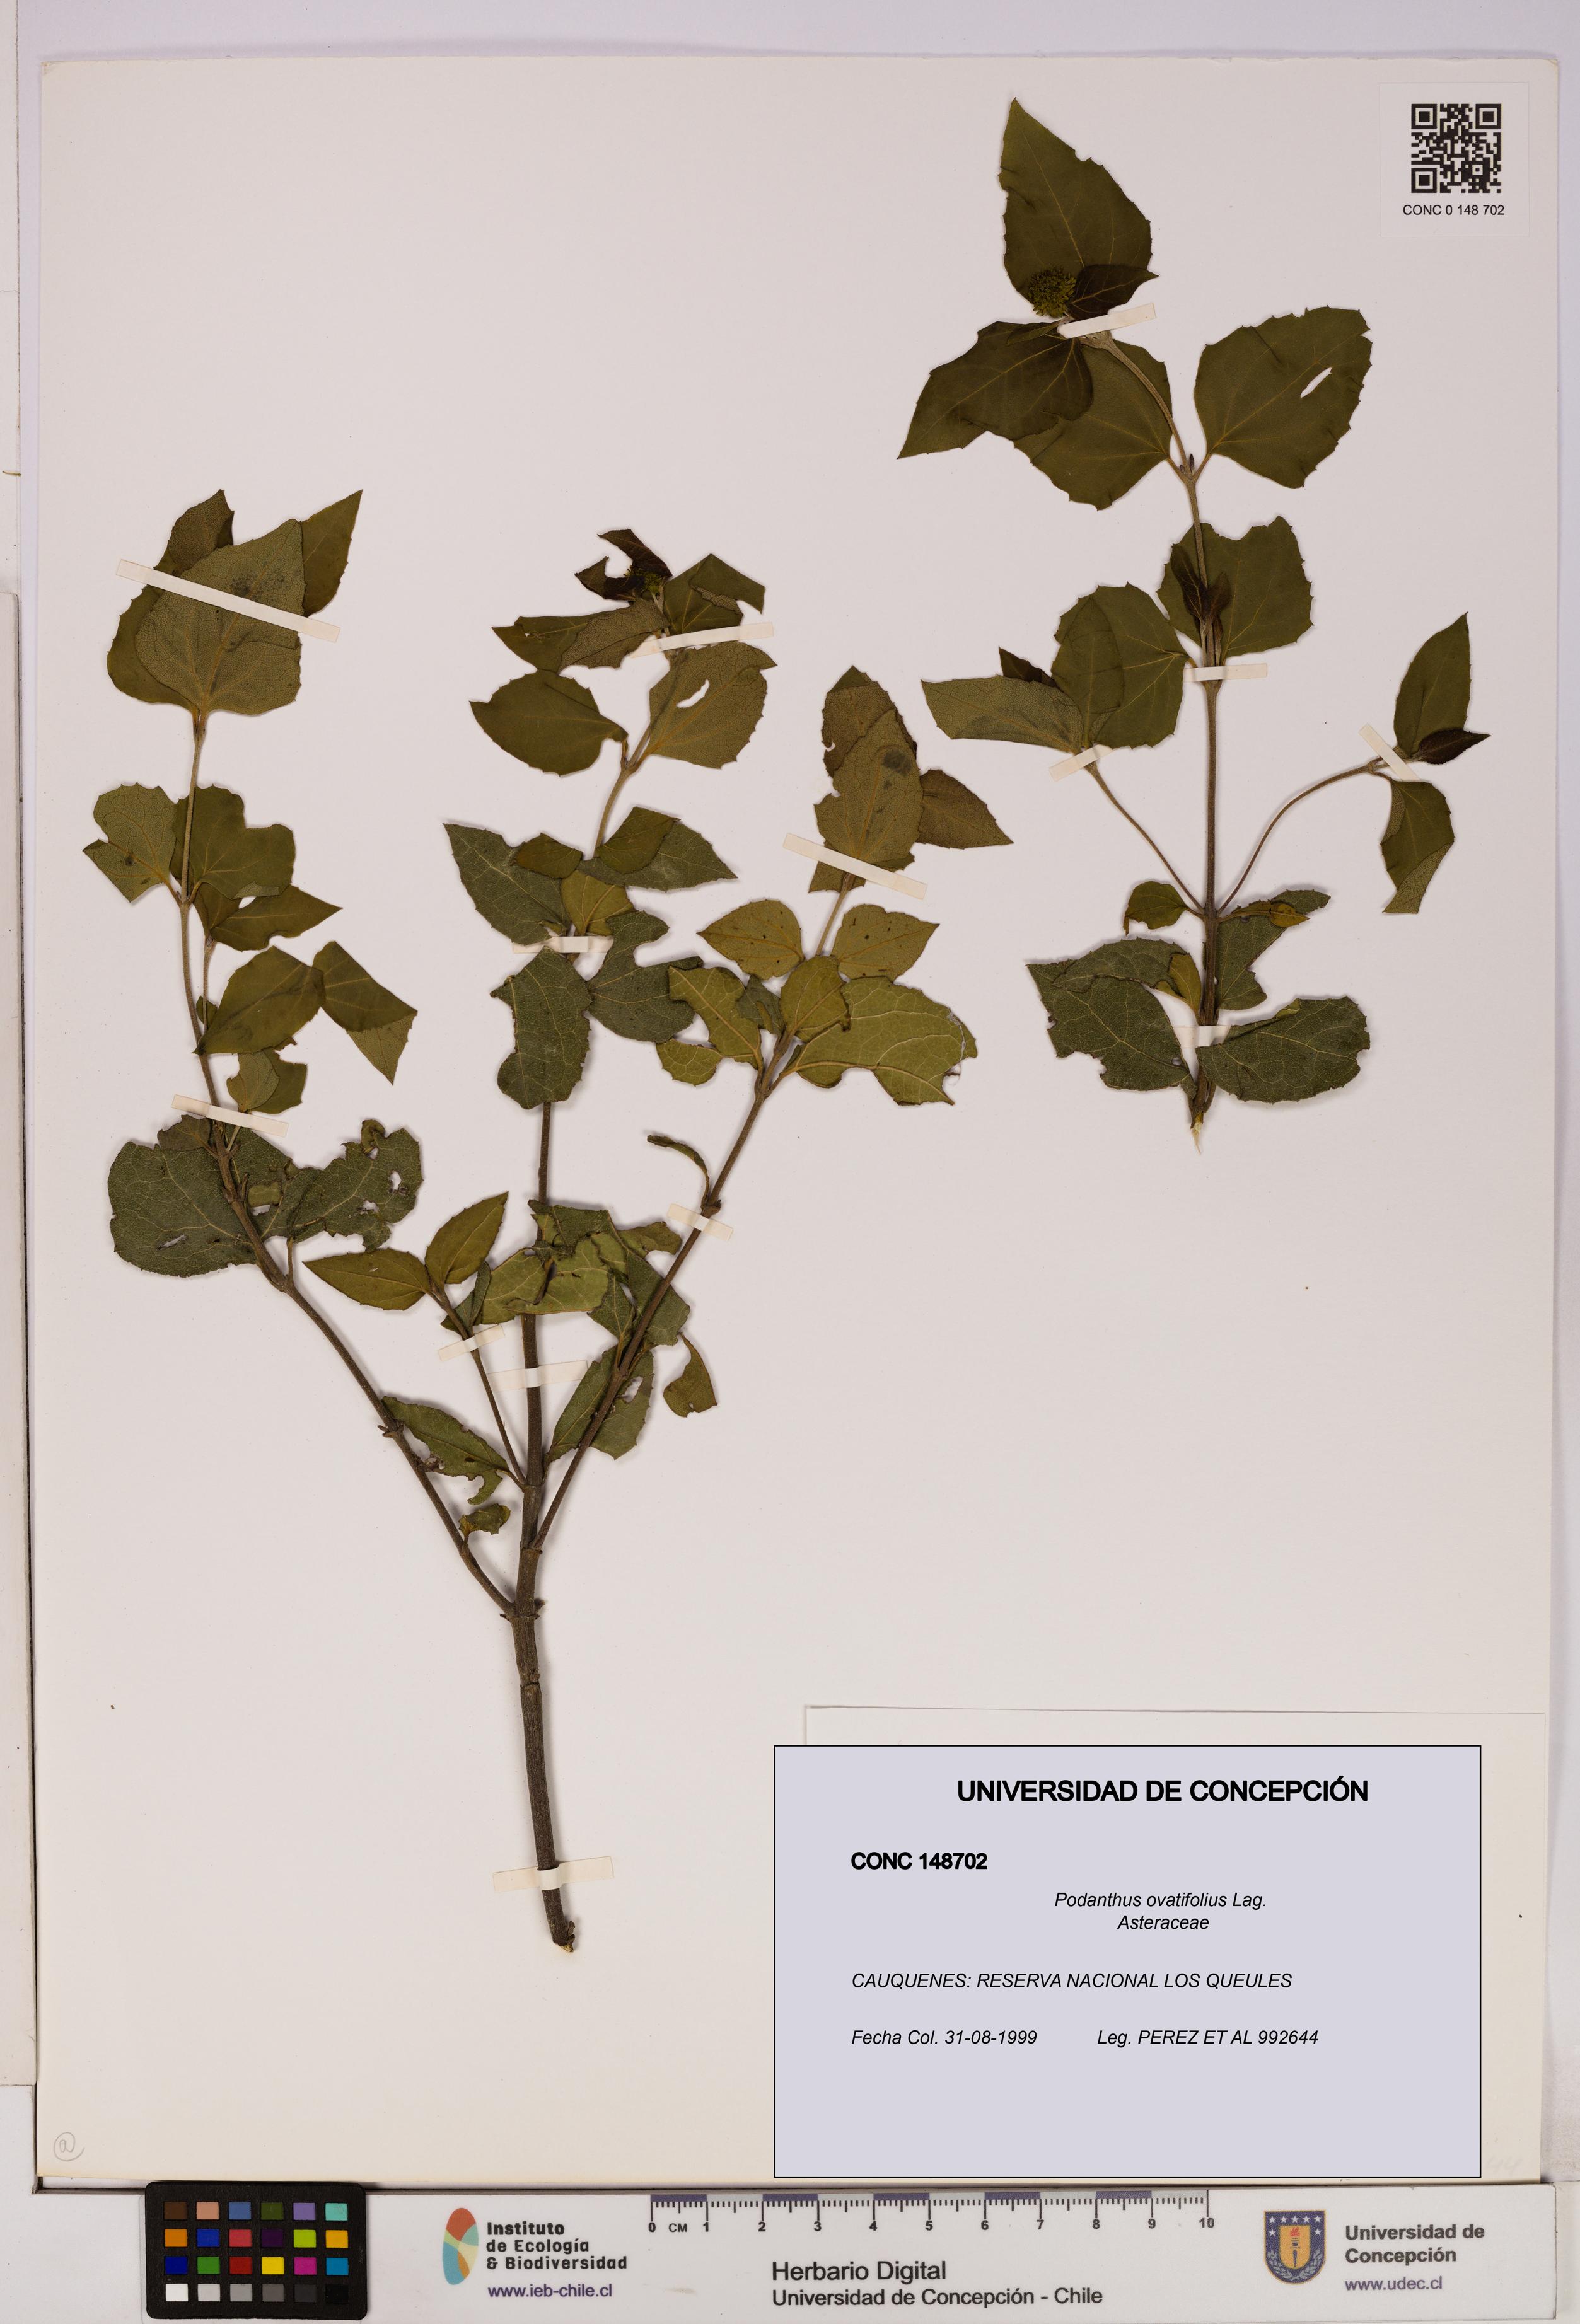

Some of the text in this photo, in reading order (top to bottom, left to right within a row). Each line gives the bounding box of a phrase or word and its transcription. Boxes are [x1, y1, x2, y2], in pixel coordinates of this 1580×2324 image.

[1402, 204, 1505, 216] CONC 0 148 702
[487, 2221, 565, 2236] Instituto
[648, 2217, 1215, 2233] 0 CM 1 2 3 4 5 6 7 8 9 10
[1345, 2223, 1485, 2241] Universidad de
[485, 2238, 589, 2255] de Ecología
[486, 2253, 627, 2270] & Biodiversidad
[1345, 2246, 1456, 2267] Concepción
[772, 2260, 946, 2284] Herbario Digital
[487, 2283, 612, 2298] www.ieb-chile.cl
[1344, 2275, 1443, 2291] www.udec.cl
[772, 2288, 885, 2306] Universidad
[891, 2288, 915, 2306] de
[921, 2287, 1035, 2309] Concepción
[1054, 2287, 1103, 2304] Chile
